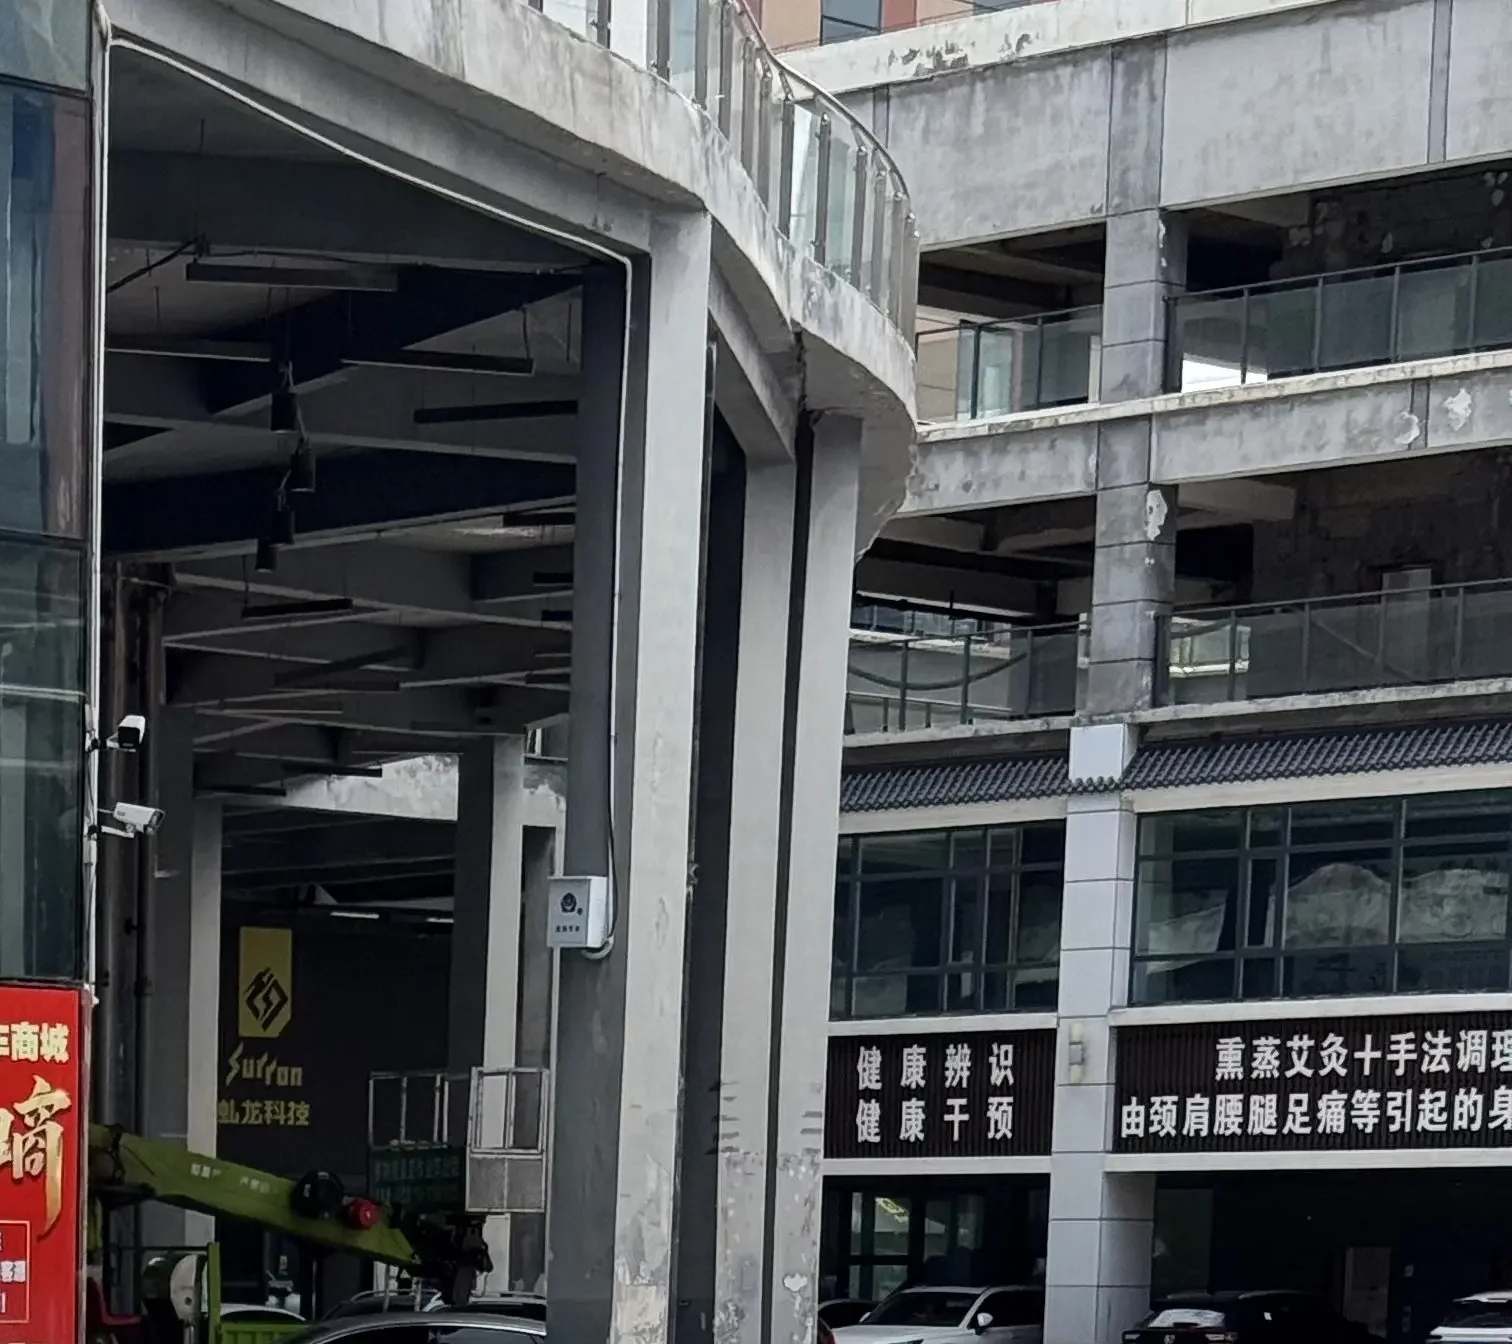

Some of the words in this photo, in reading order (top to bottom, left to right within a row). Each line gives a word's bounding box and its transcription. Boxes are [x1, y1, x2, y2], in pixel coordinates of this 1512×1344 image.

[857, 1042, 1014, 1090] 健康辨识
[855, 1096, 1014, 1143] 健康干预
[1120, 1084, 1512, 1139] 由颈肩腰腿足痛等引起的身
